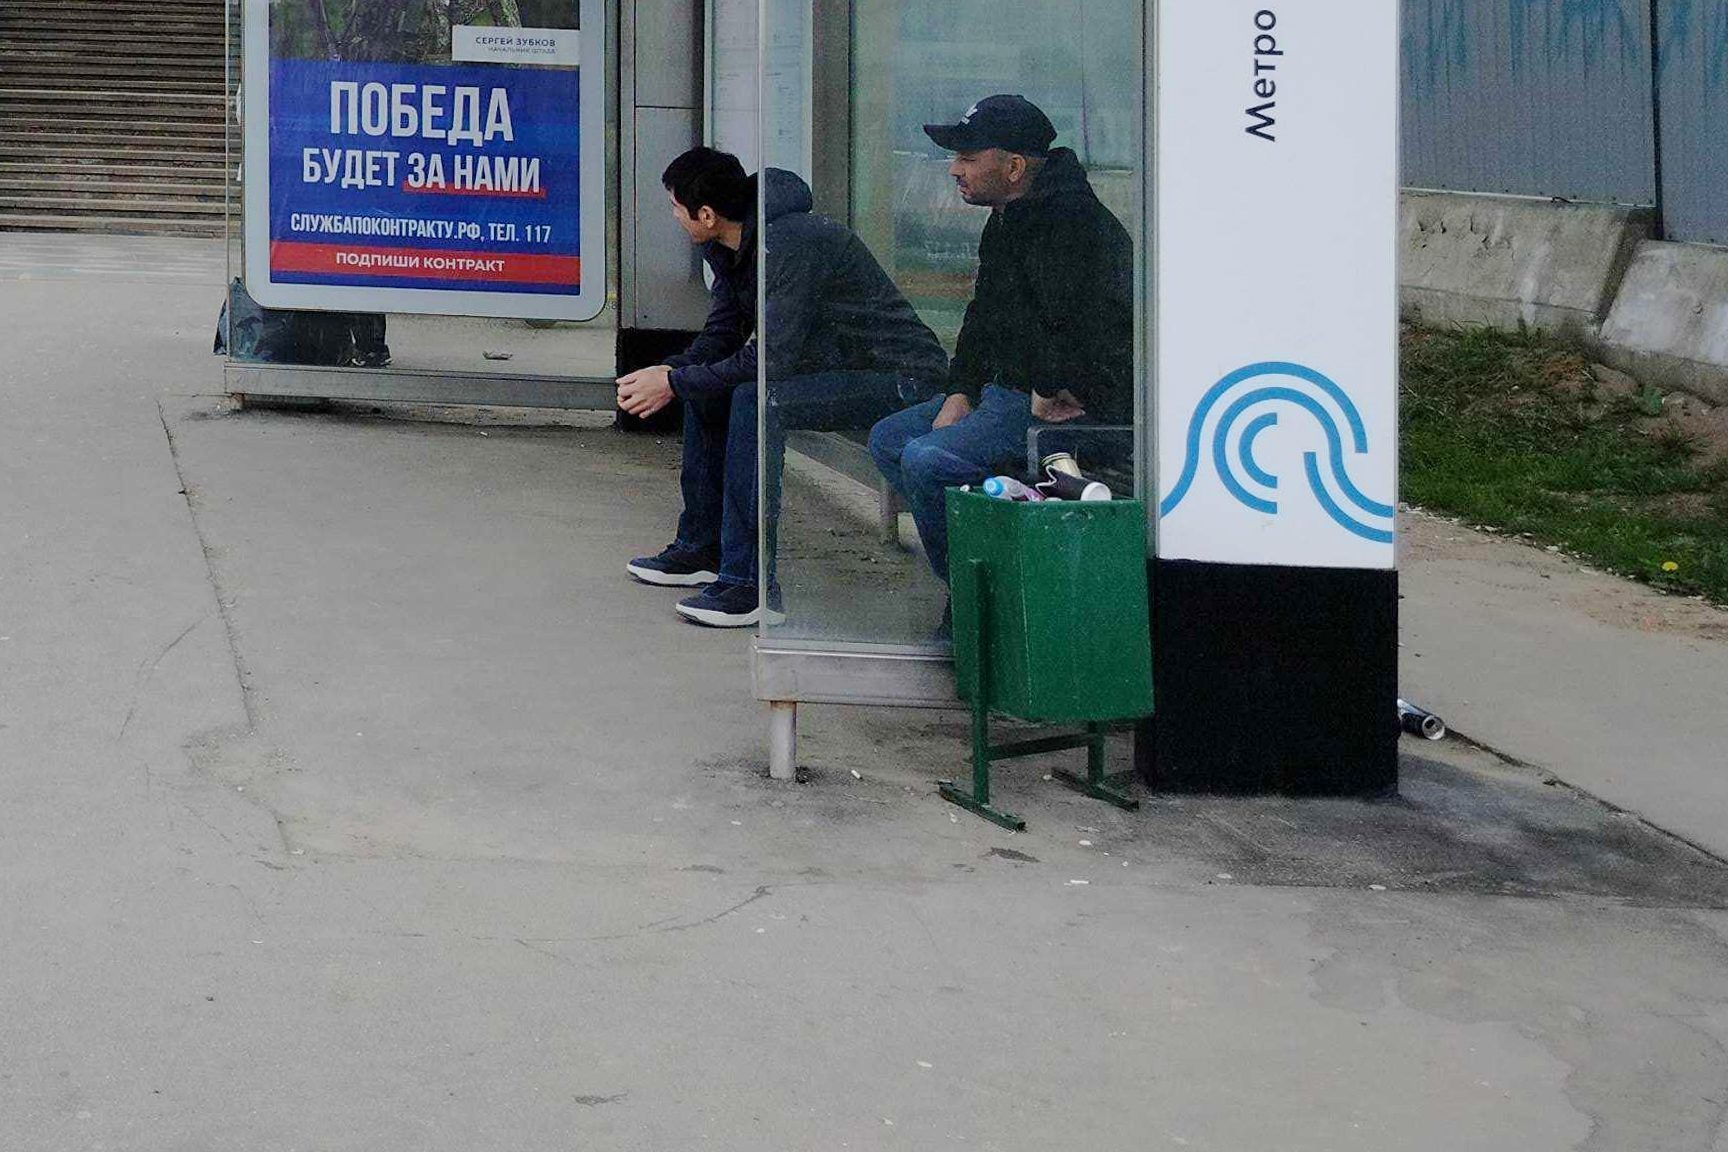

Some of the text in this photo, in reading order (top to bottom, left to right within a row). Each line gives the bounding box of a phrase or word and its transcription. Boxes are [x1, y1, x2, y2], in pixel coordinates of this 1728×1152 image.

[475, 36, 556, 47] СЕРГЕЙ ЗУБКОВ
[1244, 9, 1285, 143] Метро
[330, 80, 514, 147] ПОБЕДА
[302, 147, 541, 194] БУДЕТ ЗА НАМИ
[290, 212, 552, 244] СЛУЖБАПОКОНТРАКТУ.РФ, ТЕЛ. 117
[335, 252, 505, 273] ПОДПИШИ КОНТРАКТ
